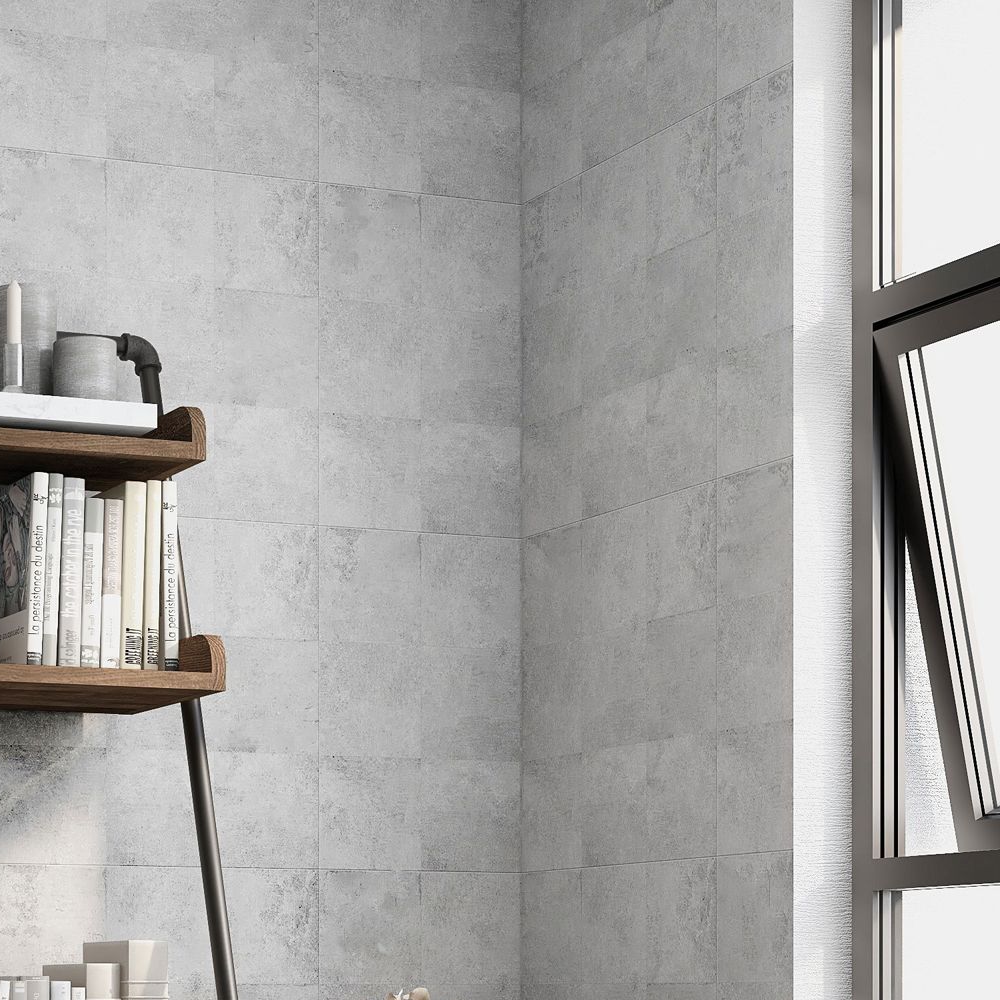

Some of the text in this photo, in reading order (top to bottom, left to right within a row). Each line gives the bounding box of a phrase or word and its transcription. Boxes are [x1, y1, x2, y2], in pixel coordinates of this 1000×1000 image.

[32, 525, 43, 552] destin
[164, 533, 176, 560] destin
[31, 556, 42, 568] du
[164, 562, 176, 575] du
[30, 570, 44, 622] persistance
[166, 578, 178, 628] persistance
